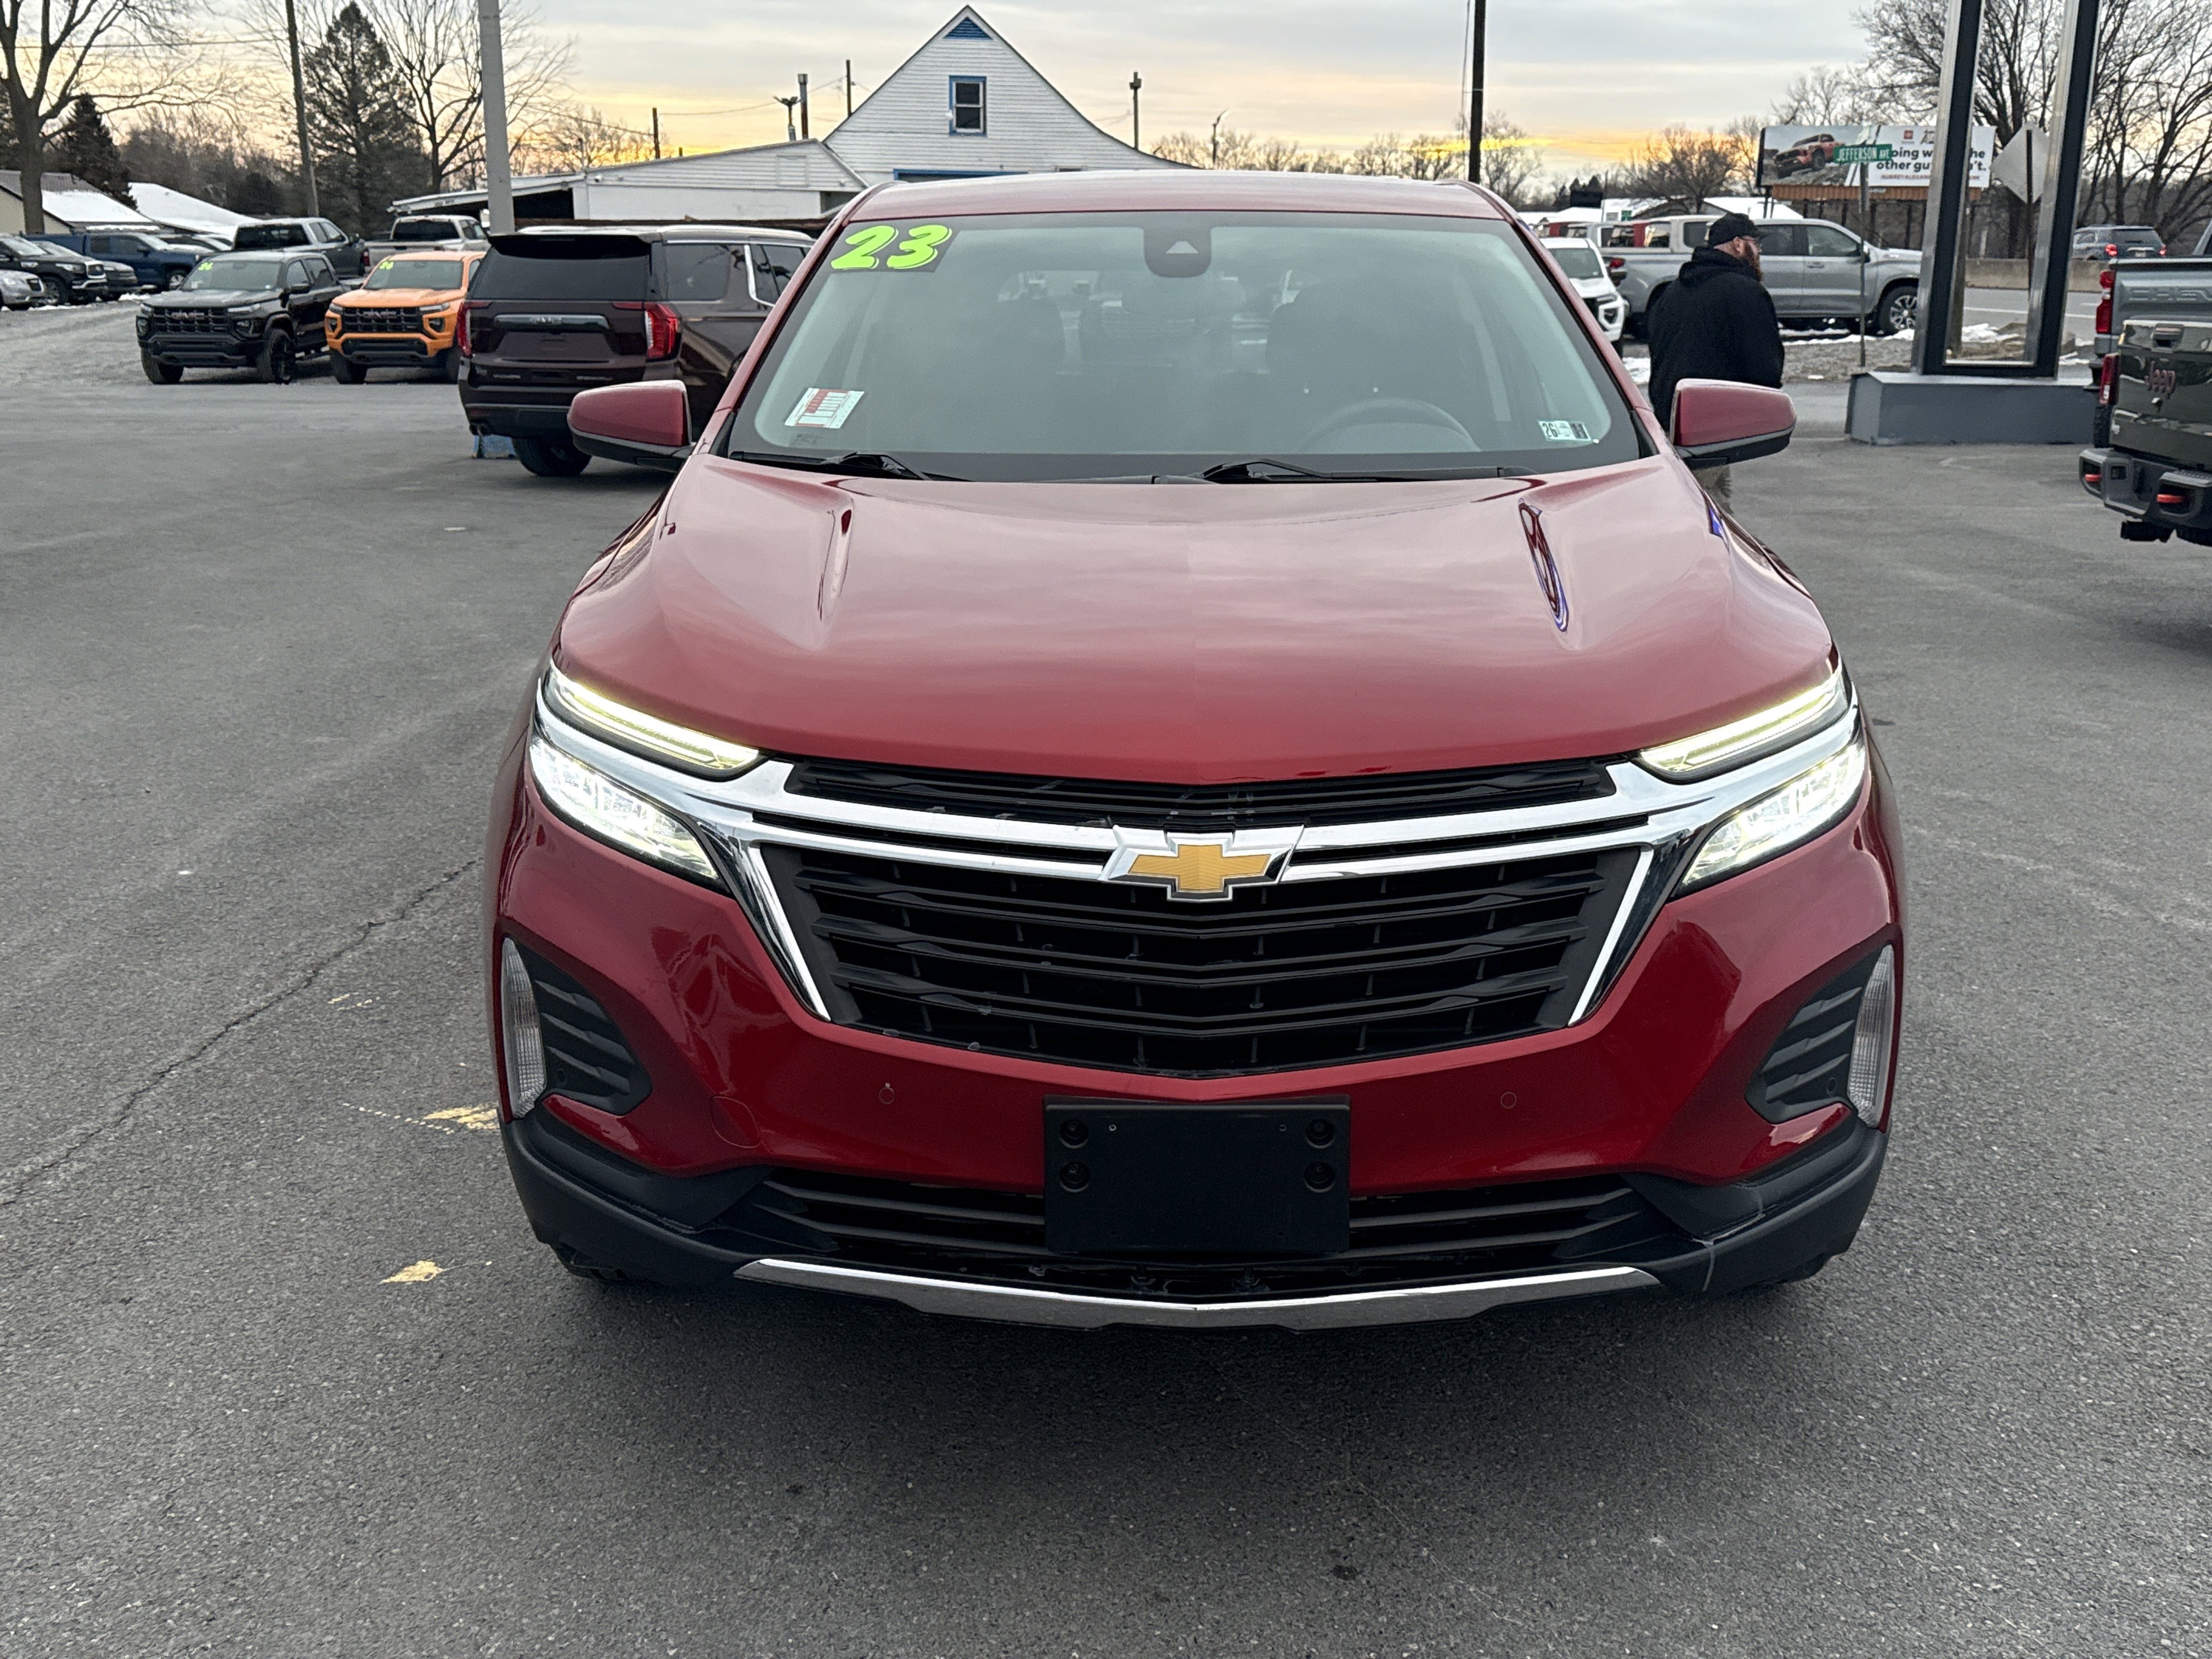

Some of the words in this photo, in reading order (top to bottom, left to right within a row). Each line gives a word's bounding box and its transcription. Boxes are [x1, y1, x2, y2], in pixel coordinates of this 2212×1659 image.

[1837, 146, 1877, 161] JEFFERSON
[1892, 146, 1919, 160] oing
[1876, 159, 1911, 170] other
[1914, 162, 1930, 172] gu
[831, 224, 952, 269] 23
[2145, 361, 2176, 396] Jeep
[1542, 422, 1558, 438] 26
[1571, 422, 1589, 439] 11
